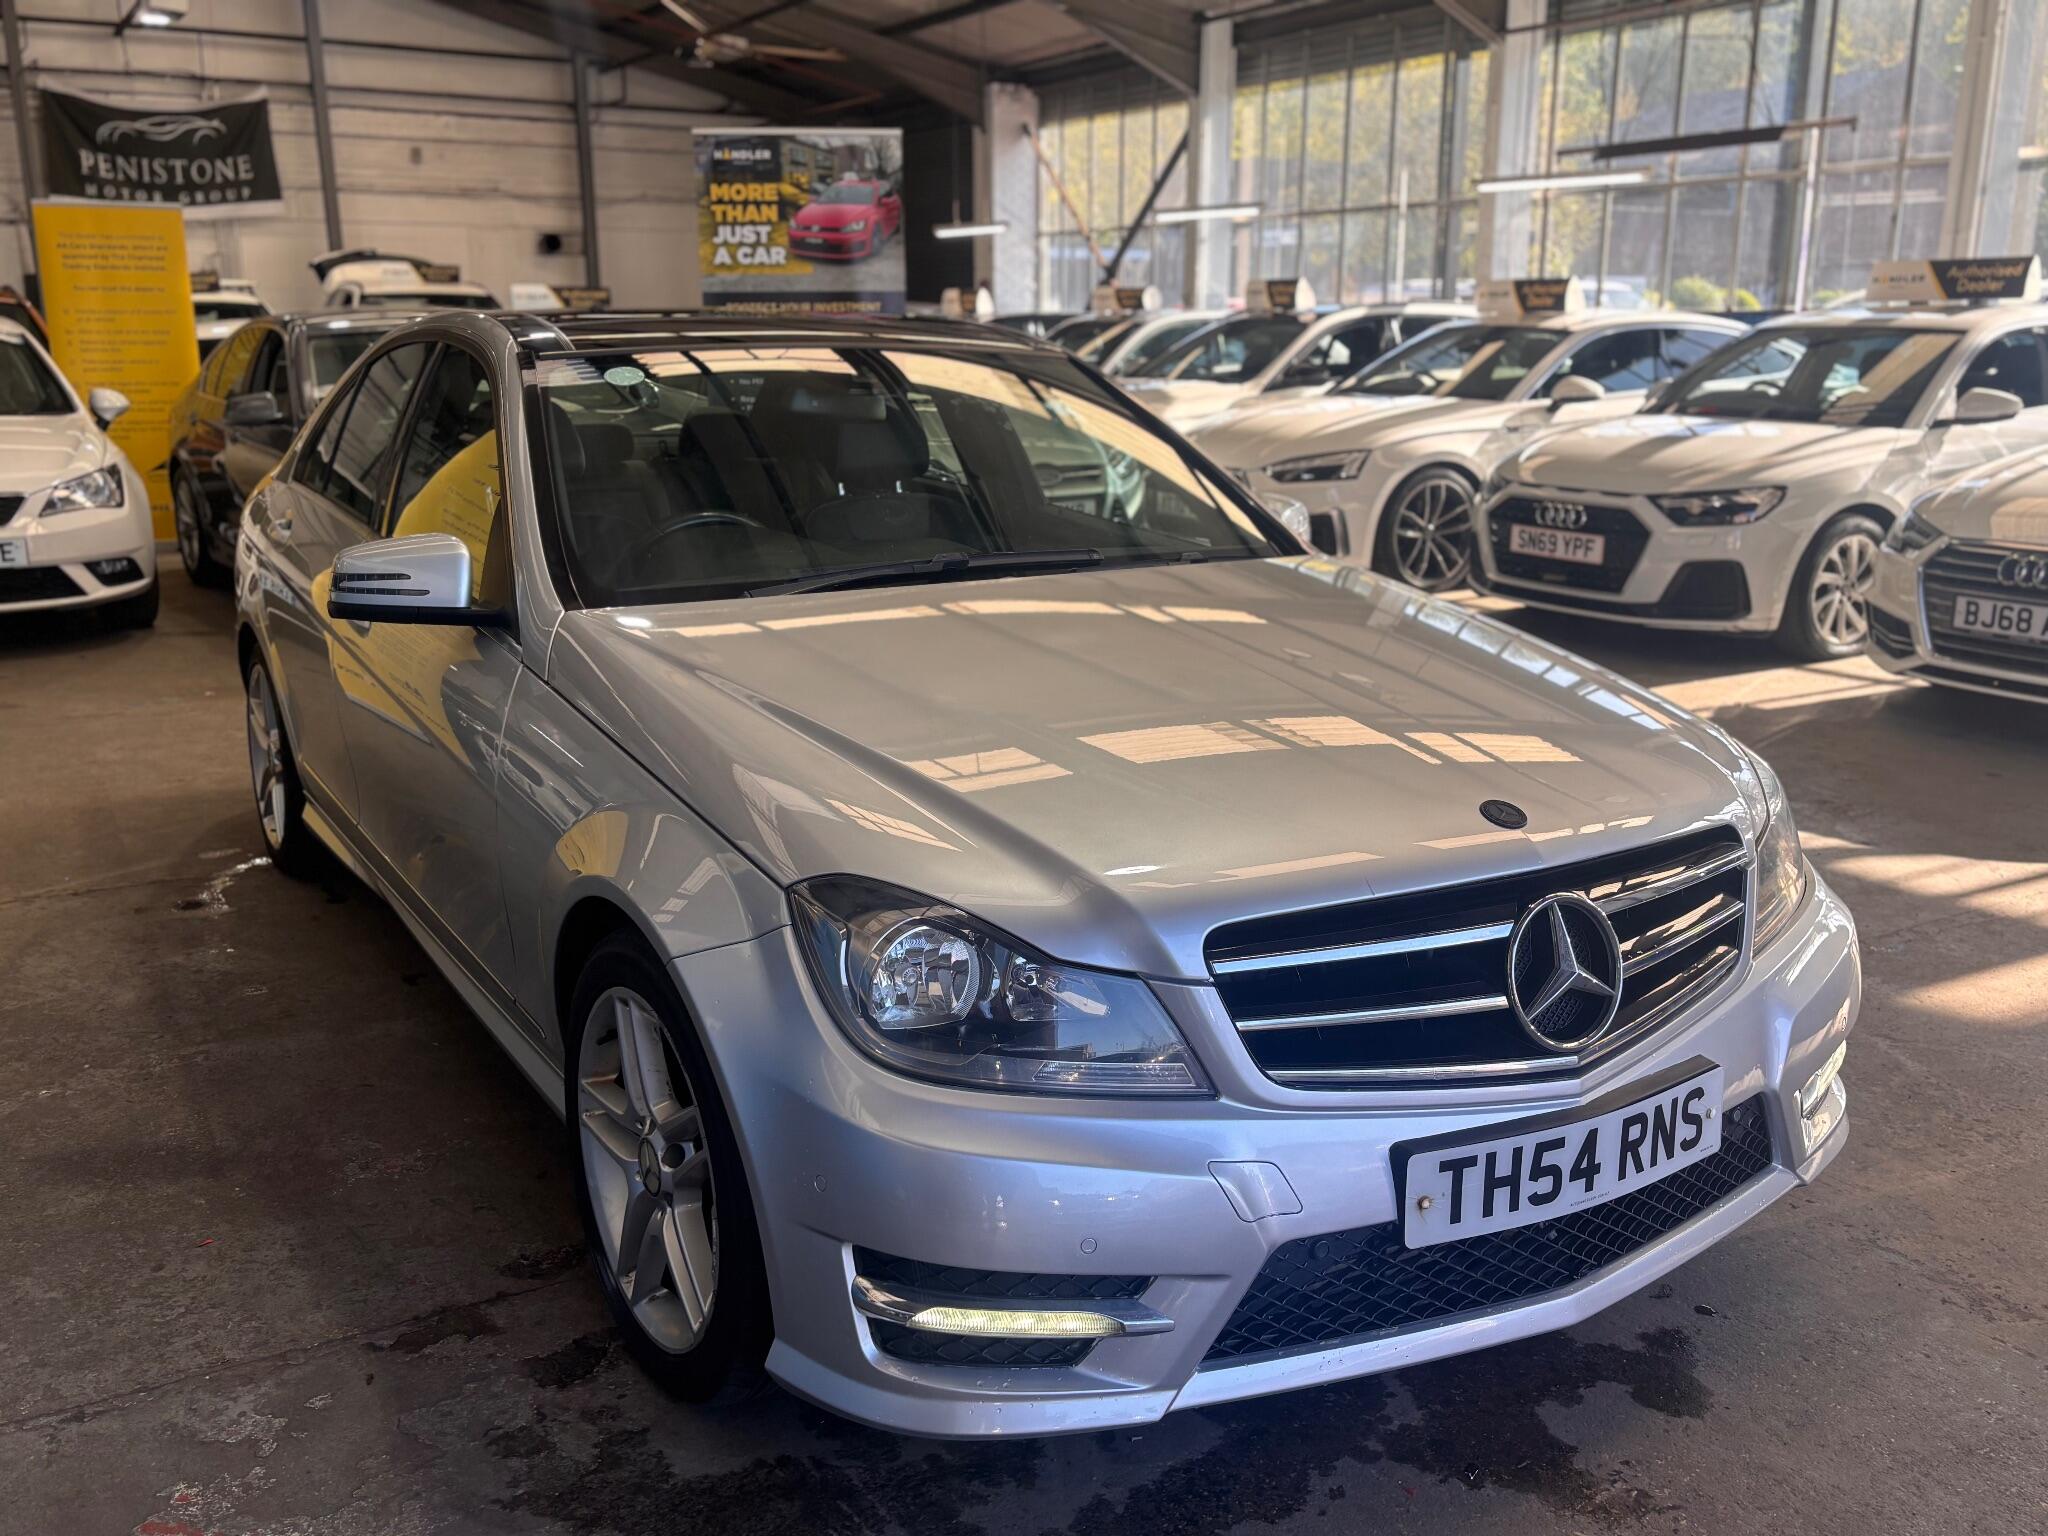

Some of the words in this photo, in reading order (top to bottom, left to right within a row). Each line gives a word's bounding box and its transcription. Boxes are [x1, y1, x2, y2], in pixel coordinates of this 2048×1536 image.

[79, 149, 254, 185] PENISTONE
[178, 187, 253, 204] GROUP
[710, 183, 779, 202] MORE
[710, 204, 779, 223] THAN
[713, 225, 772, 244] JUST
[713, 247, 732, 265] A
[736, 247, 787, 266] CAR
[1518, 528, 1557, 553] SN69
[1563, 536, 1596, 558] YPF
[1964, 600, 2033, 633] BJ68
[1438, 1127, 1602, 1225] TH54
[1618, 1086, 1705, 1182] RNS
